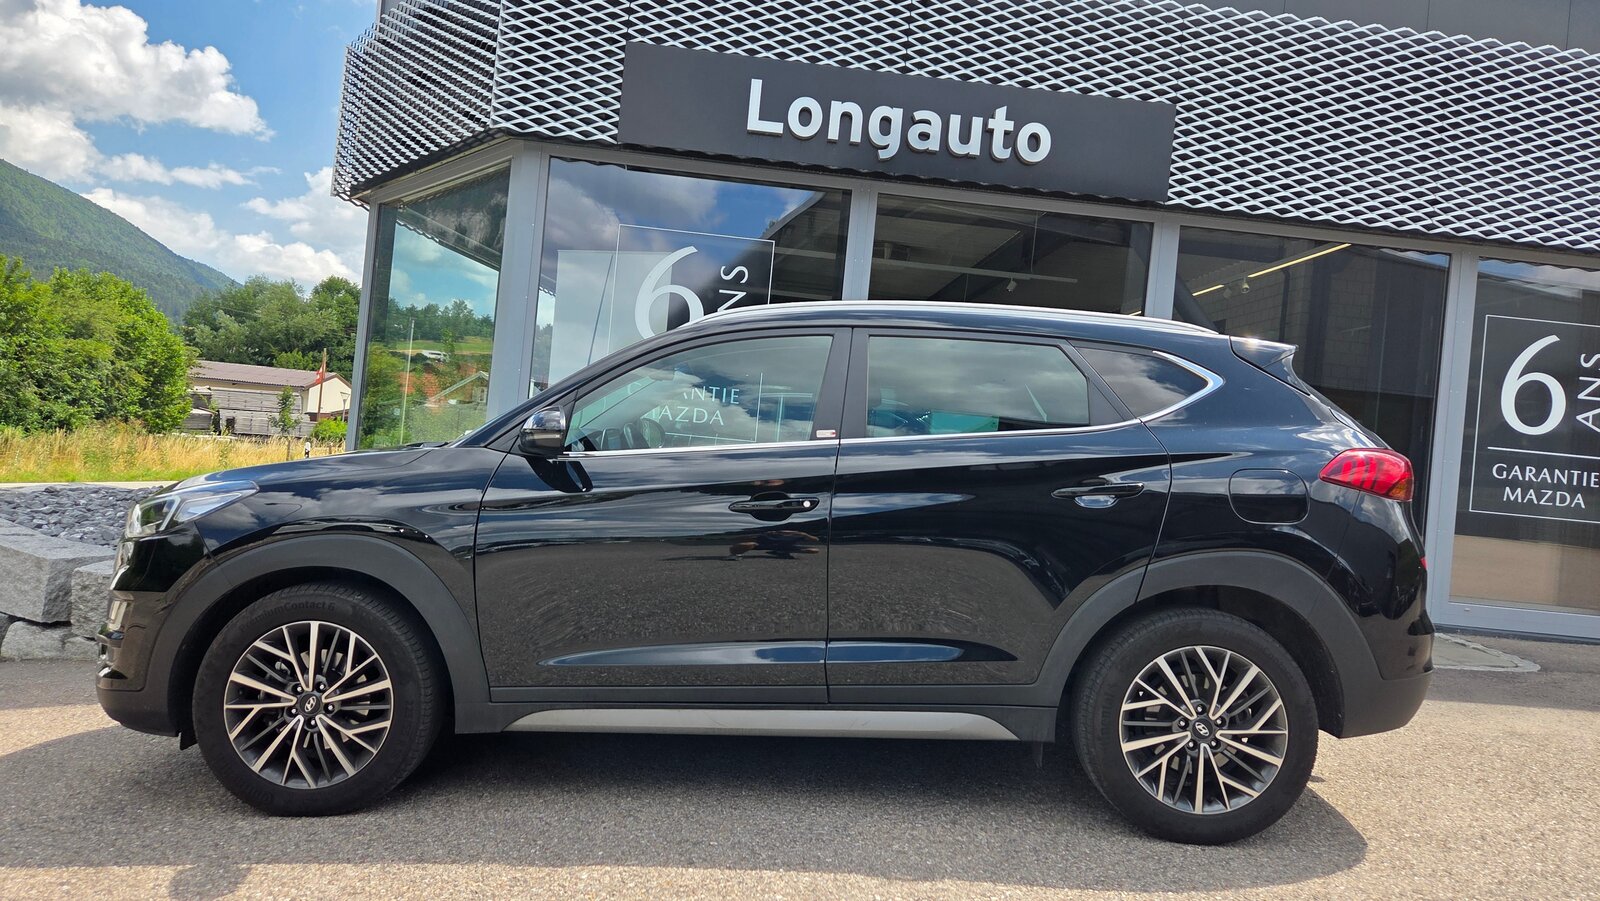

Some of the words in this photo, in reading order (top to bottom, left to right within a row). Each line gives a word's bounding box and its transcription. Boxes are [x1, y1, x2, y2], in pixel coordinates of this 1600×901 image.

[747, 78, 1052, 164] Longauto
[635, 245, 704, 340] 6
[717, 265, 749, 312] NS
[1500, 334, 1566, 436] 6
[1492, 463, 1600, 488] GARANTIE
[1503, 486, 1586, 509] MAZDA
